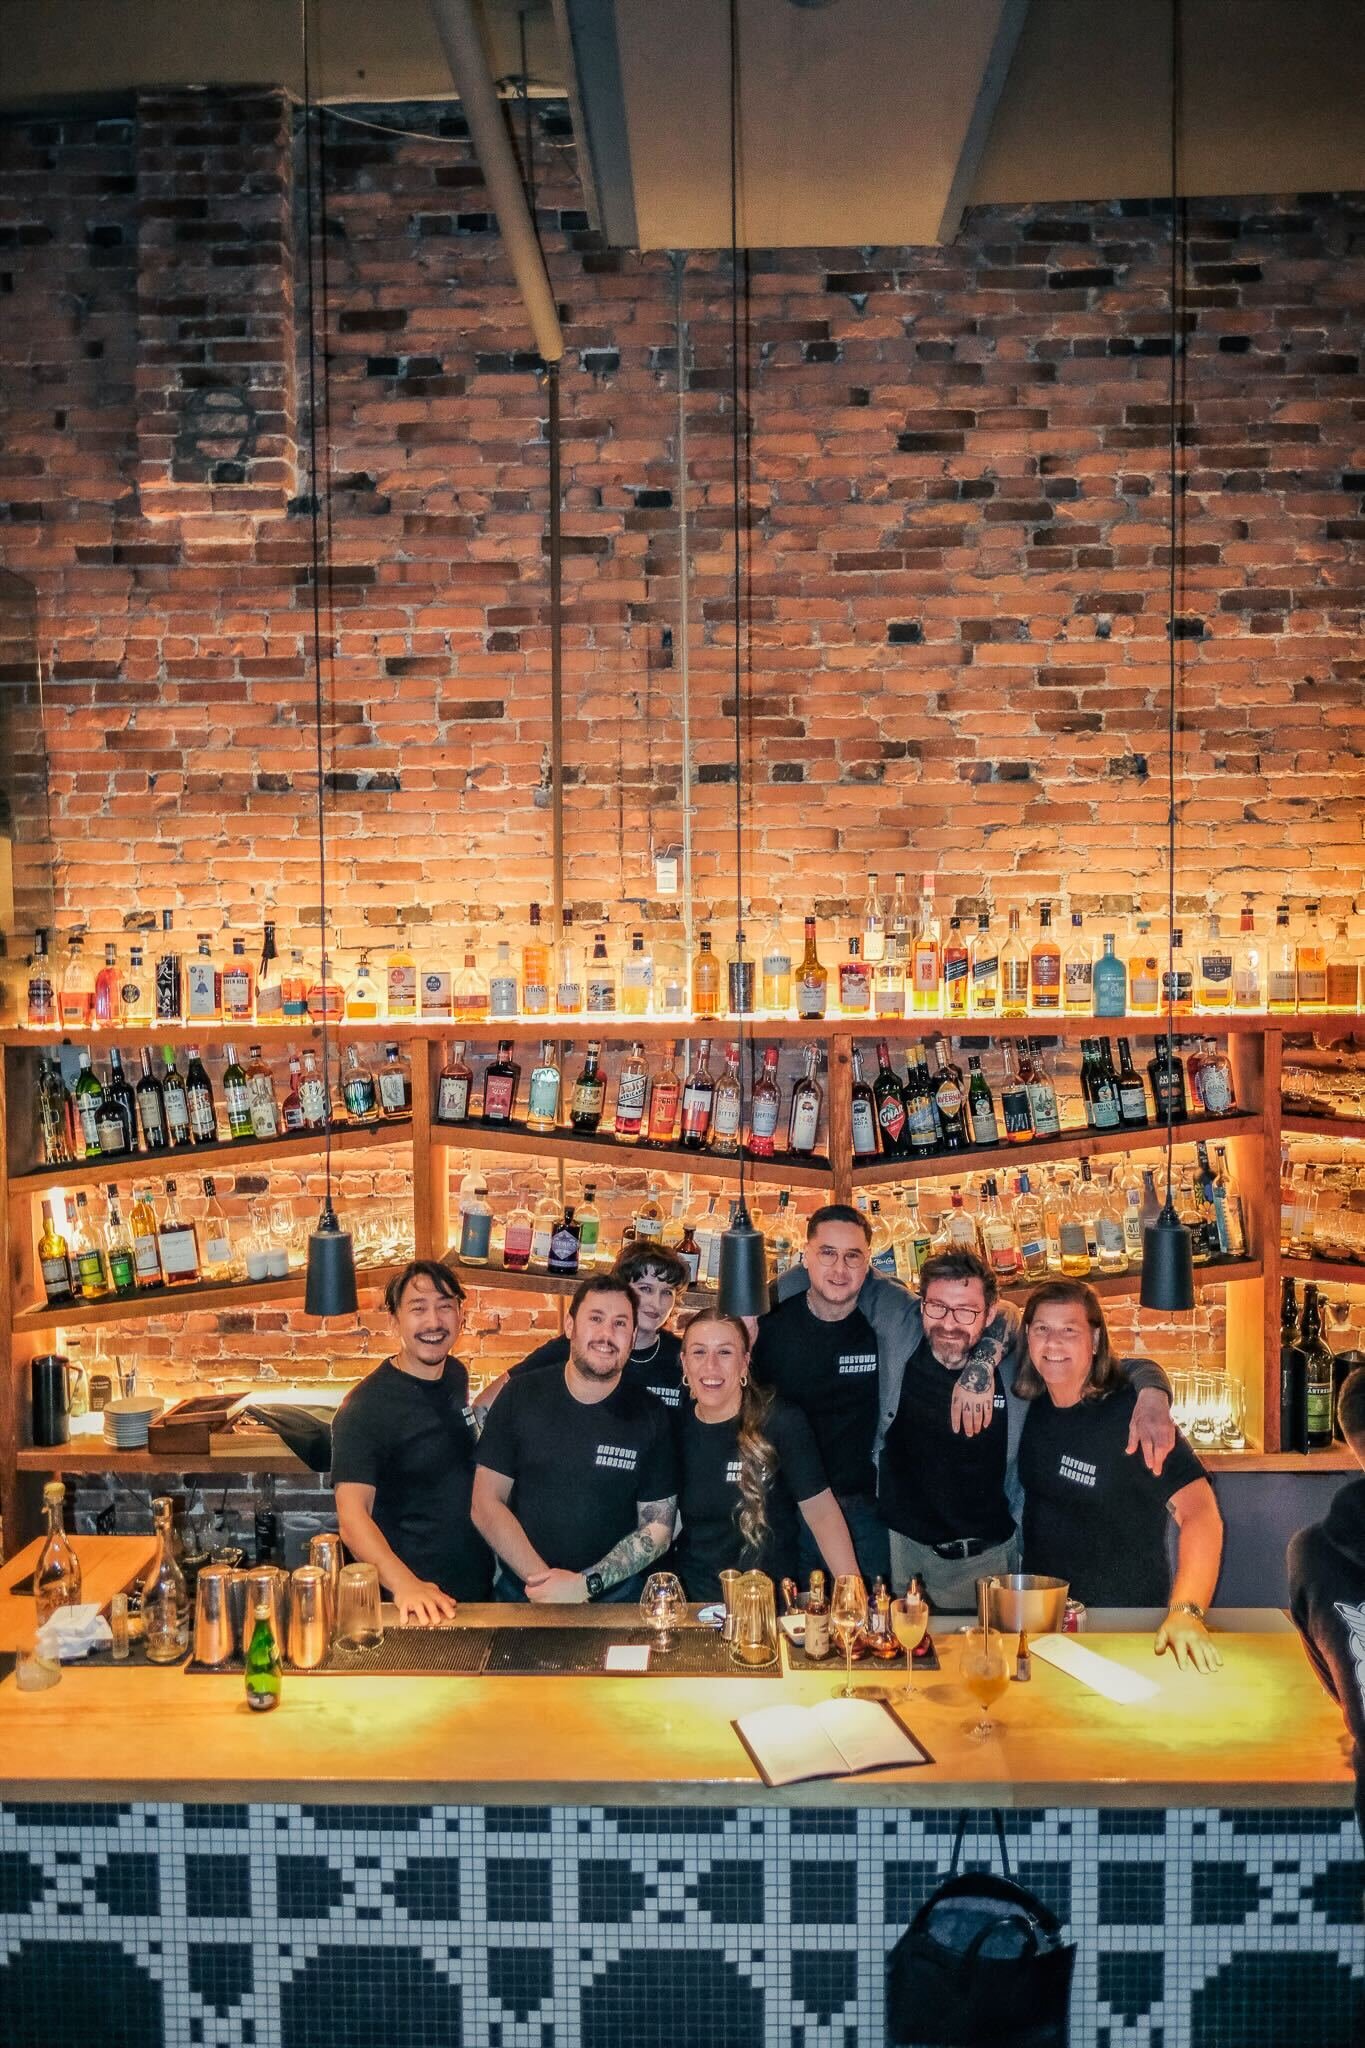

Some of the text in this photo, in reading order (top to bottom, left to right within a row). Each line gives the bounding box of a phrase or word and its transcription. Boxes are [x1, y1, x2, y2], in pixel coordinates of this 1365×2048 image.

[937, 1094, 961, 1104] AVERNA
[880, 1104, 904, 1127] CYNAR
[839, 1355, 876, 1364] GASTOWN
[839, 1363, 877, 1373] CLASSICS
[596, 1444, 638, 1460] GASTOWN
[595, 1455, 637, 1470] CLASSICS
[1061, 1455, 1096, 1475] GASTOWN
[1059, 1465, 1096, 1486] CLASSICS
